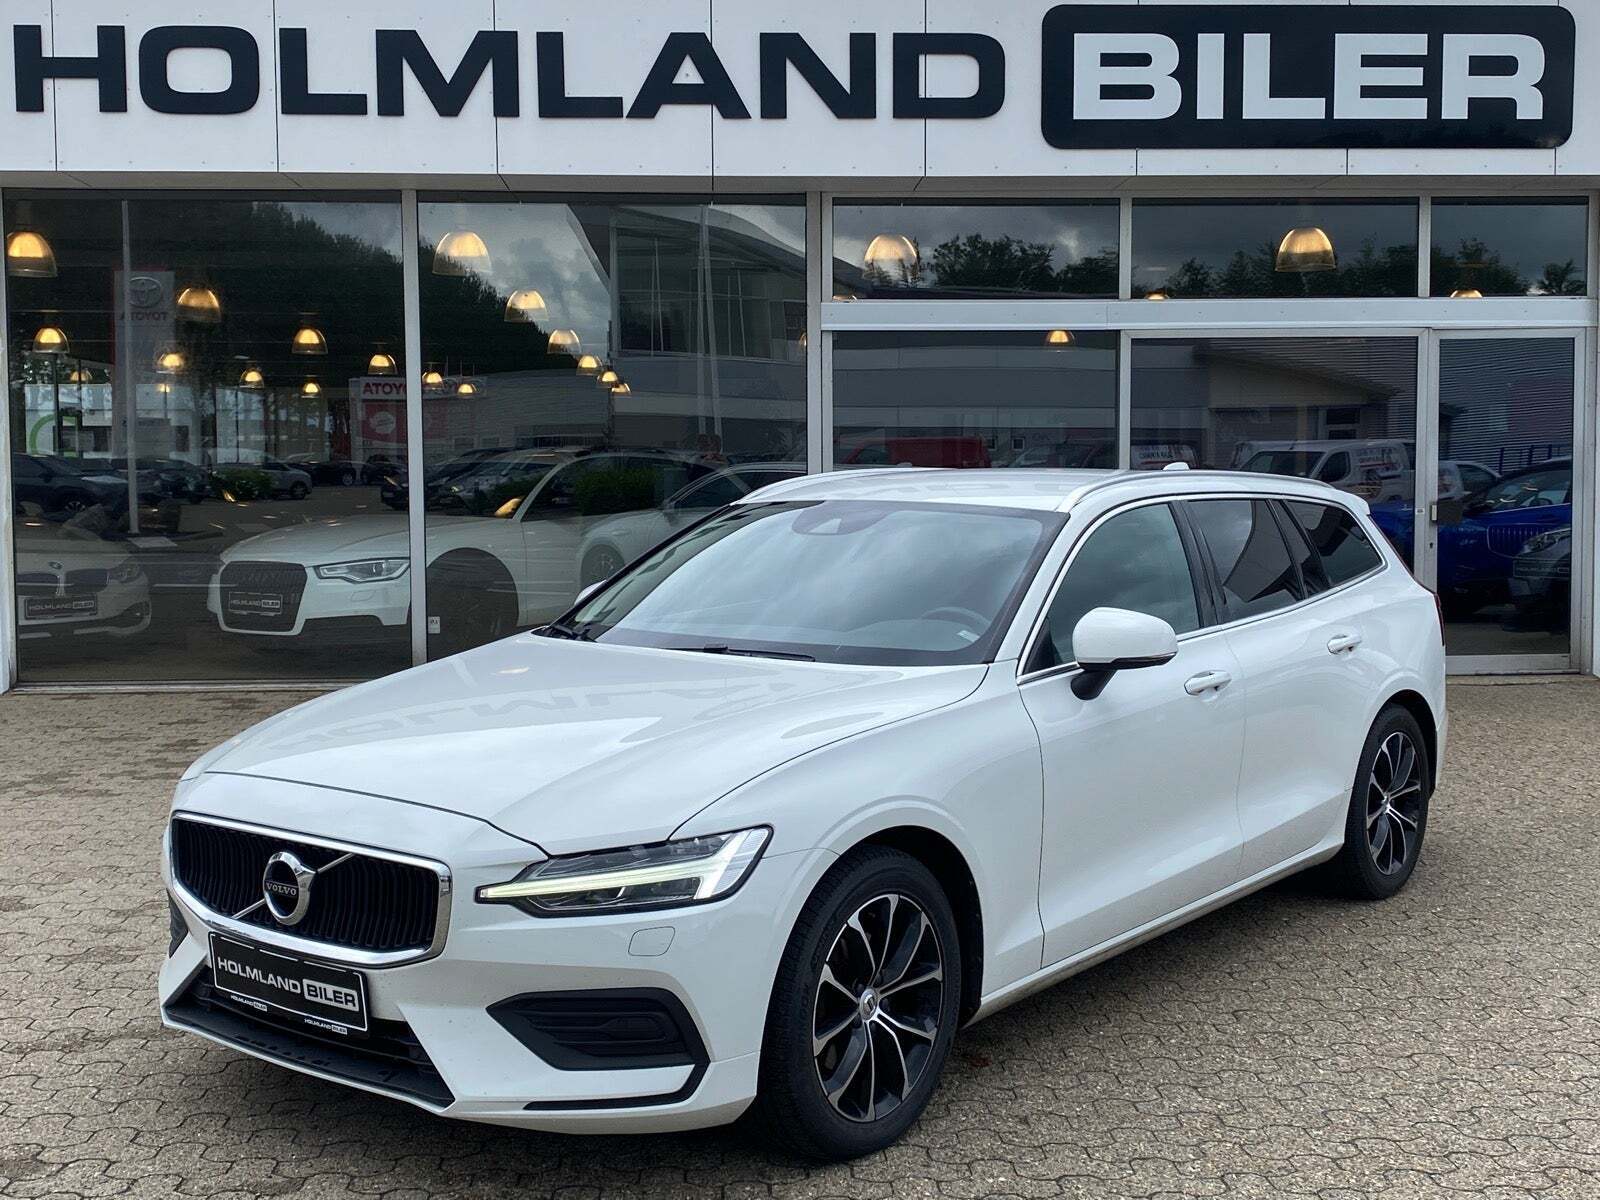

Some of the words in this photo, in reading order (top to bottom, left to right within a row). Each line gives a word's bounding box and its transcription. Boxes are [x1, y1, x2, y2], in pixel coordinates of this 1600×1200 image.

[13, 24, 1006, 120] HOLMLAND
[1073, 32, 1546, 120] BILER
[266, 882, 297, 896] VOLVO
[217, 956, 301, 994] HOLMLAND
[307, 984, 356, 1007] BILER
